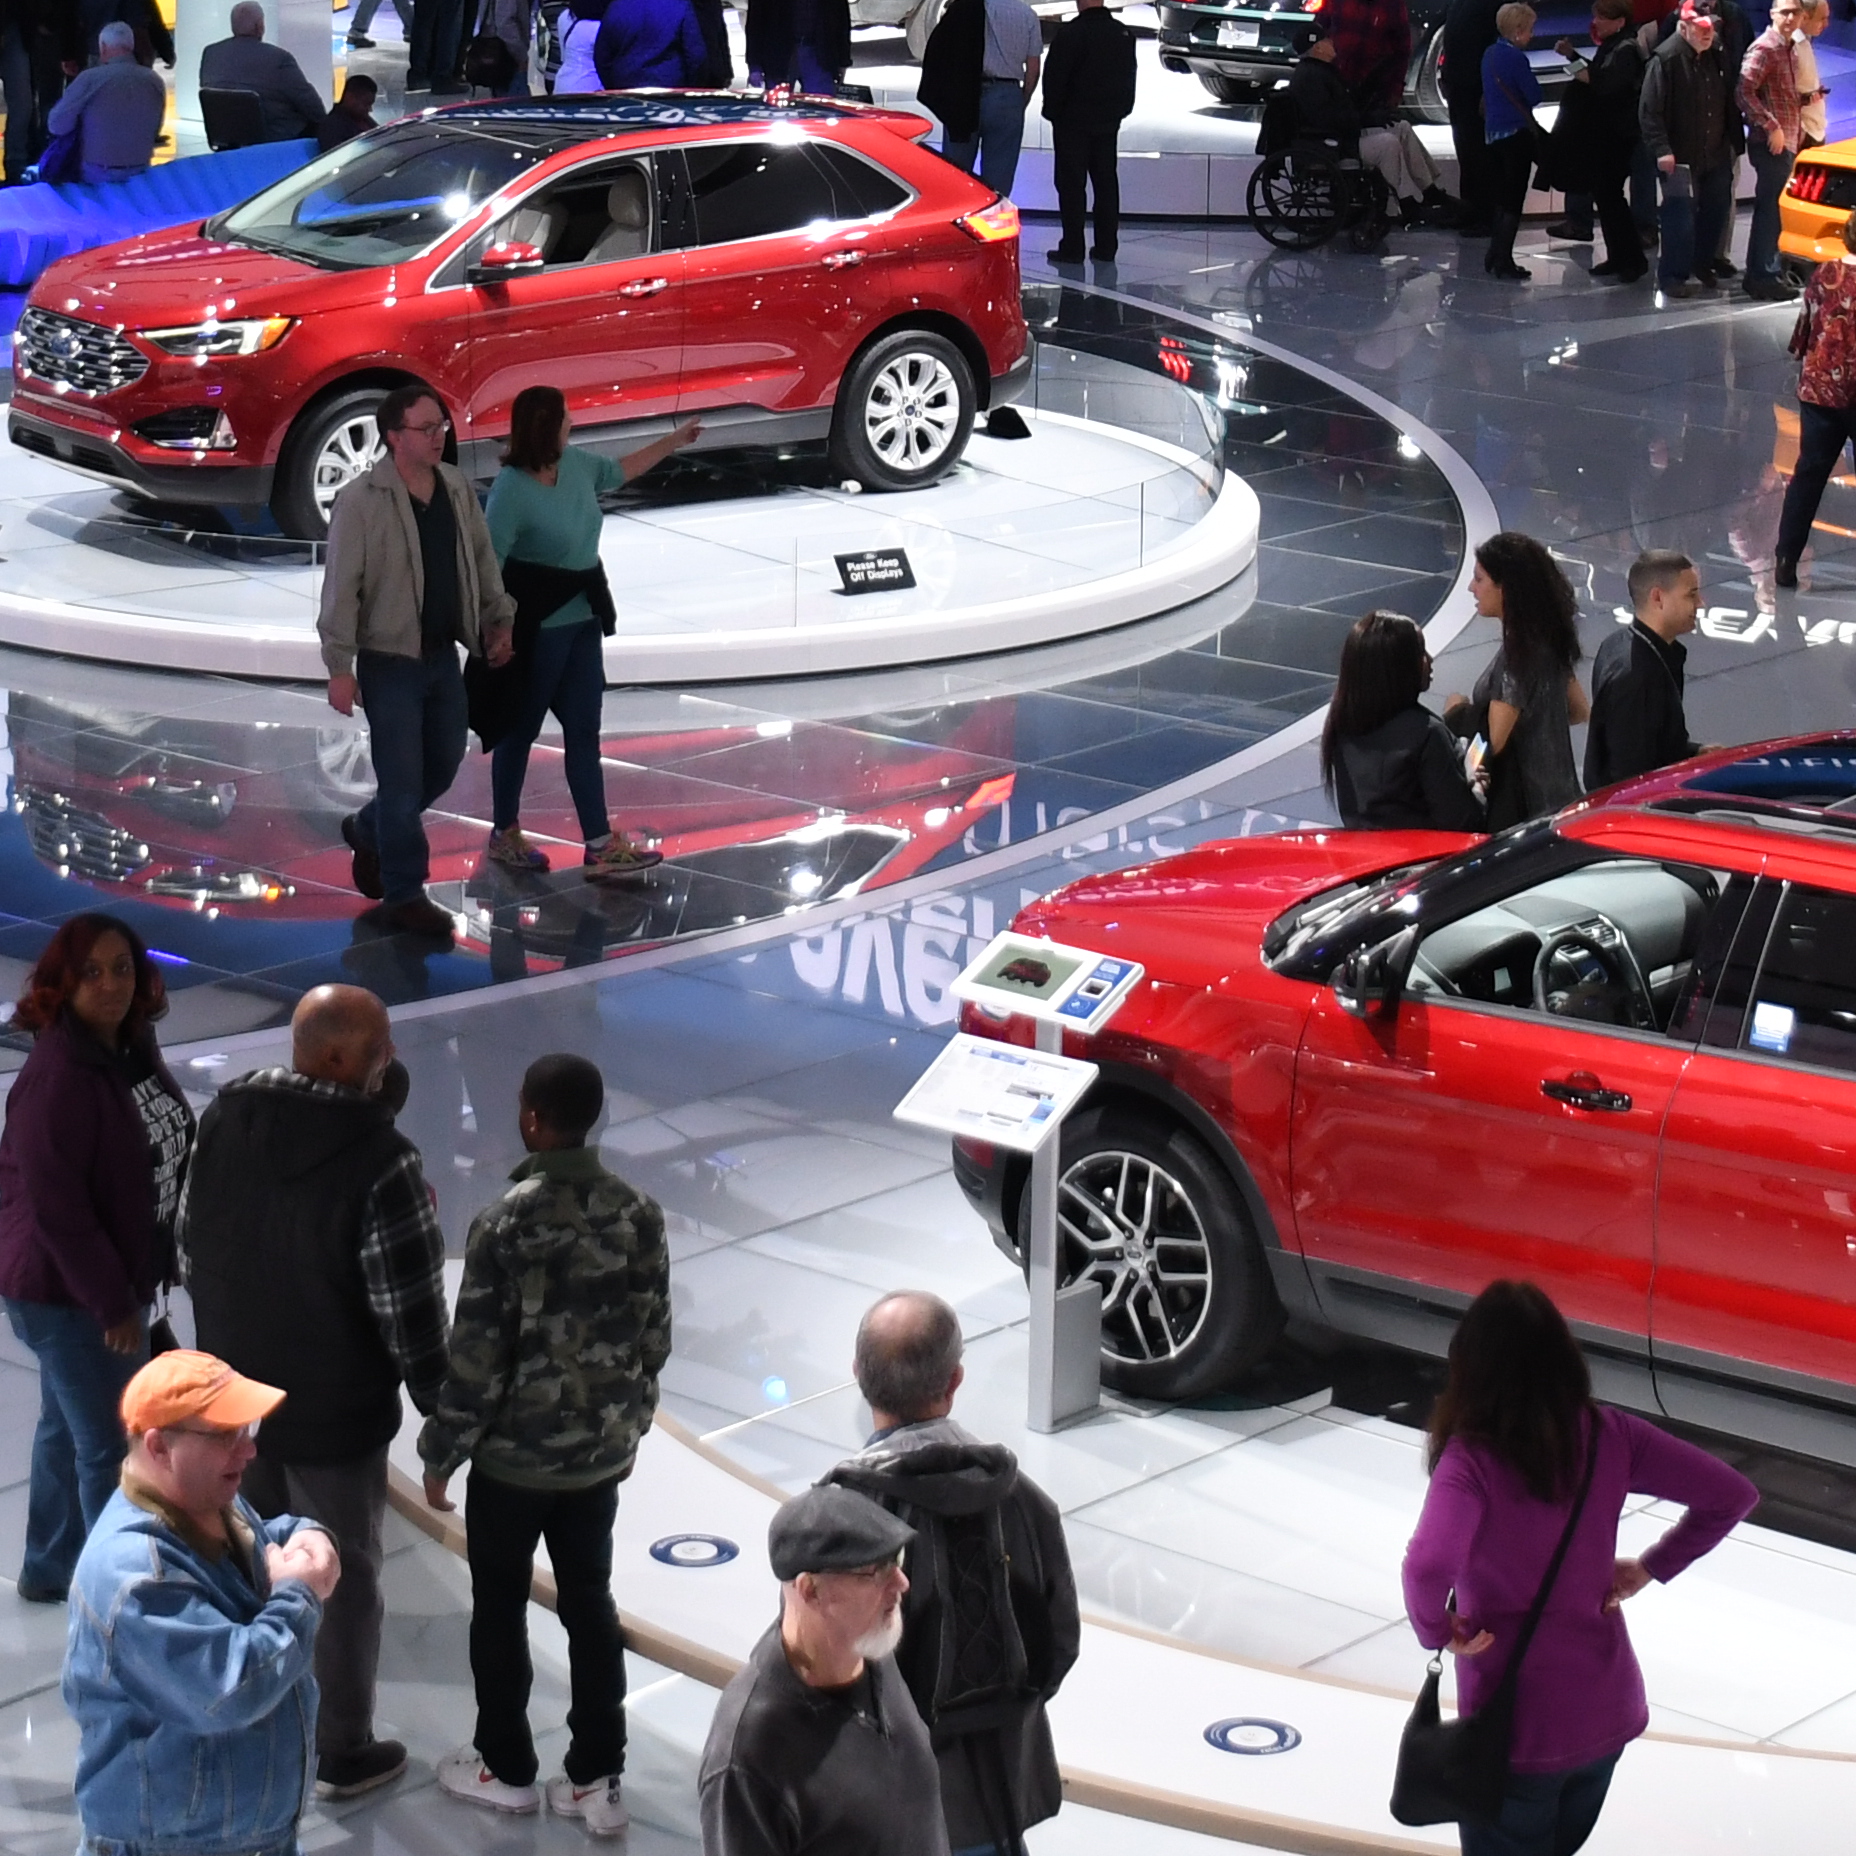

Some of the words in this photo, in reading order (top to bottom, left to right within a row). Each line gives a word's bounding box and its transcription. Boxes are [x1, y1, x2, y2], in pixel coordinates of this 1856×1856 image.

[846, 561, 876, 572] Please
[876, 557, 900, 568] Keep
[850, 572, 865, 582] Off
[867, 568, 904, 581] Displays
